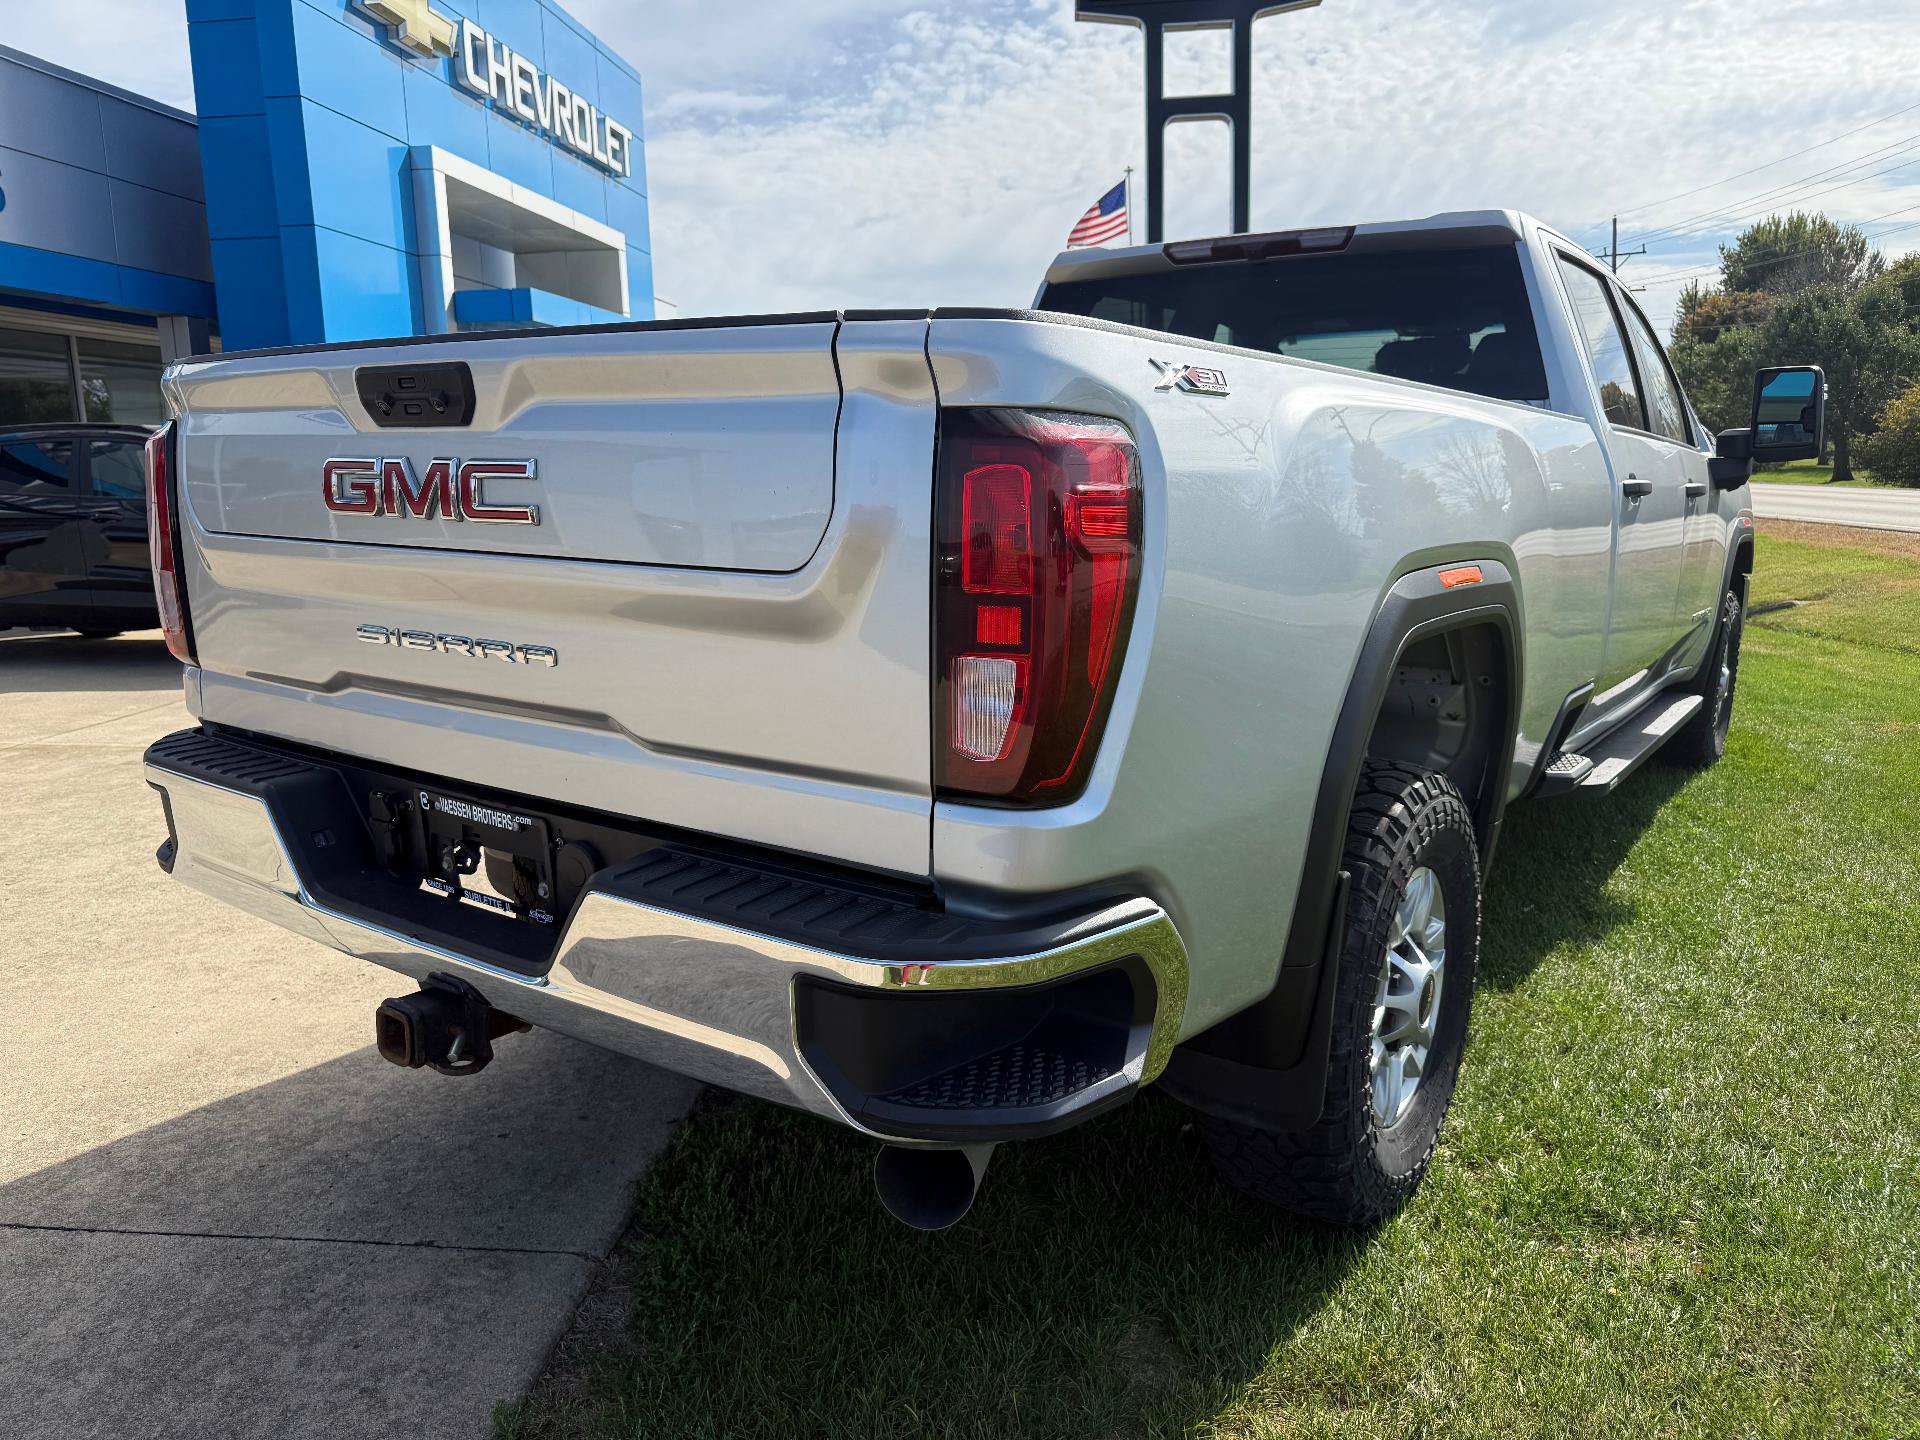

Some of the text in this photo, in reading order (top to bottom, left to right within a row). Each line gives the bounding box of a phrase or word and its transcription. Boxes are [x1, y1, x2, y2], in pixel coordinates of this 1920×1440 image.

[462, 18, 633, 178] CHEVROLET
[322, 457, 541, 526] GMC
[356, 623, 558, 667] SIERRA
[439, 797, 472, 820] VAESSEN
